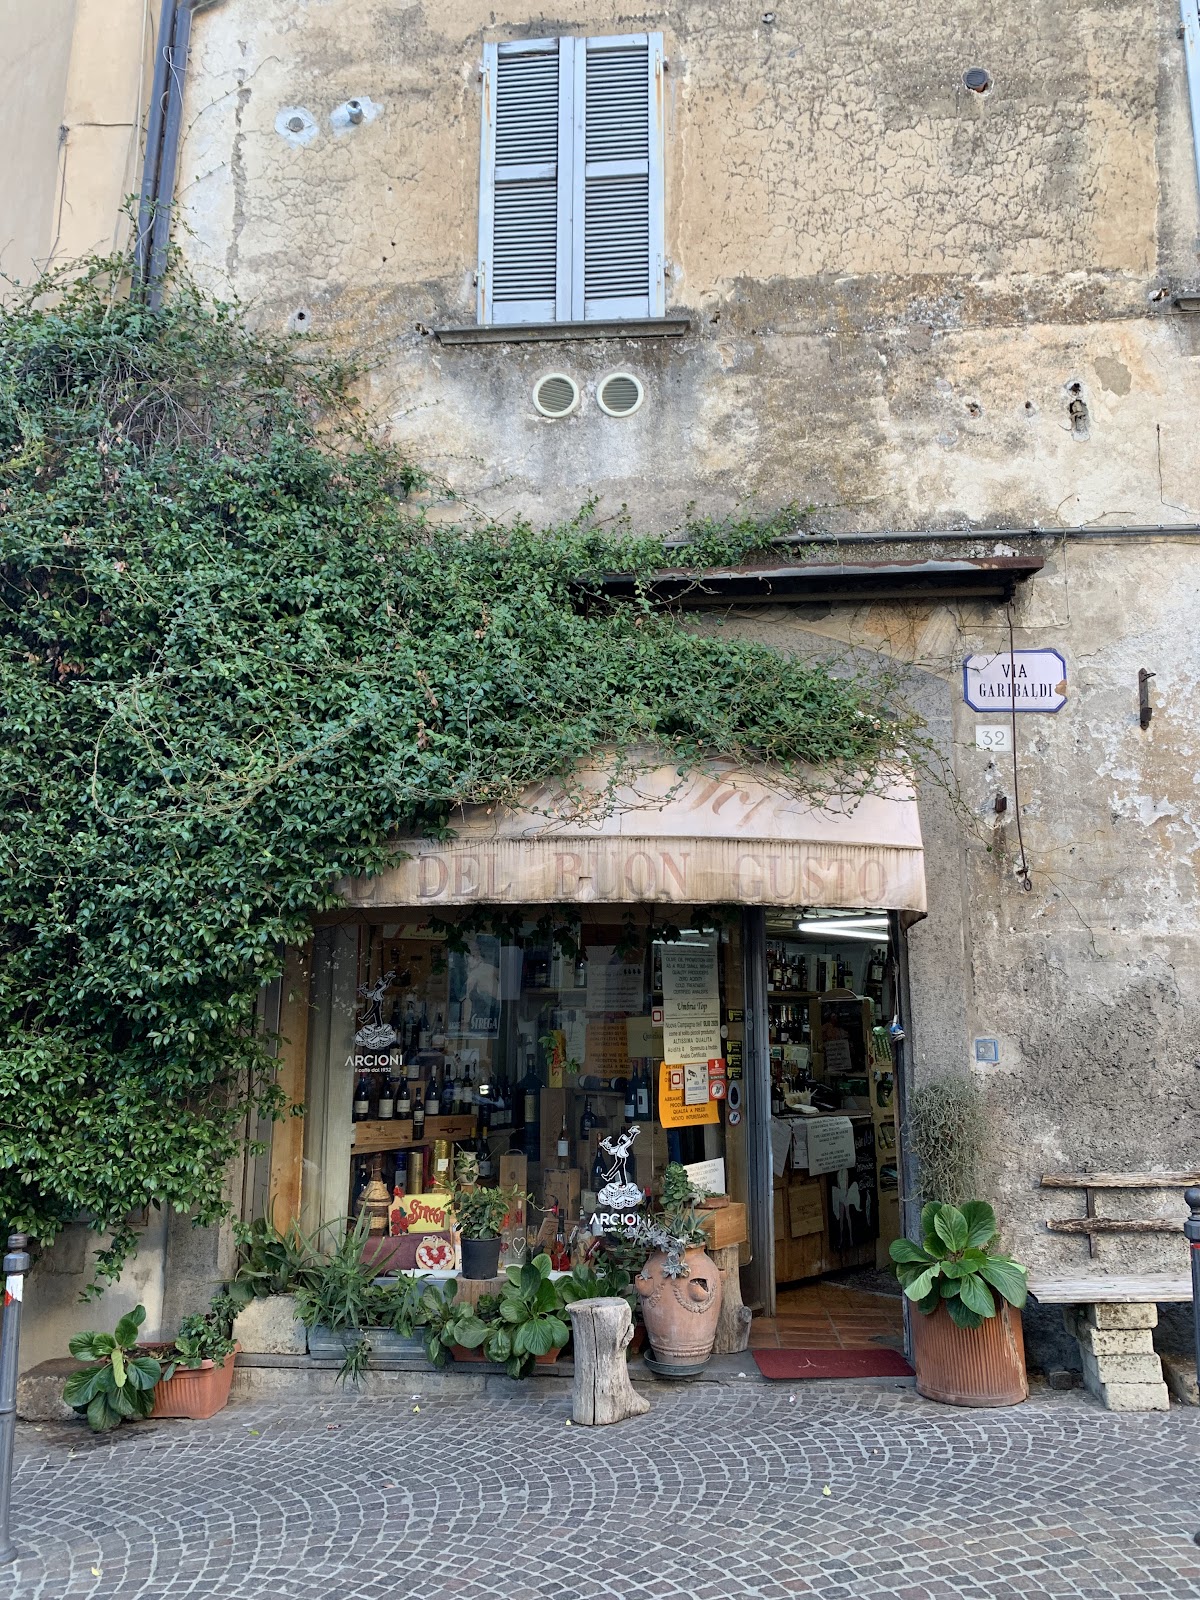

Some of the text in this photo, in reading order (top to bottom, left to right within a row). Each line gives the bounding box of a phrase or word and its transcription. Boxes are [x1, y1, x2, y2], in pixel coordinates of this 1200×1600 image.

[1002, 664, 1027, 678] VIA
[979, 683, 1053, 697] GARIBALDI
[982, 731, 1005, 745] 32
[416, 853, 511, 899] DEL
[553, 852, 690, 898] BUON
[732, 853, 887, 902] GUSTO
[697, 1001, 708, 1012] Top
[471, 1013, 498, 1029] STREGA
[344, 1054, 403, 1066] ARCIONI
